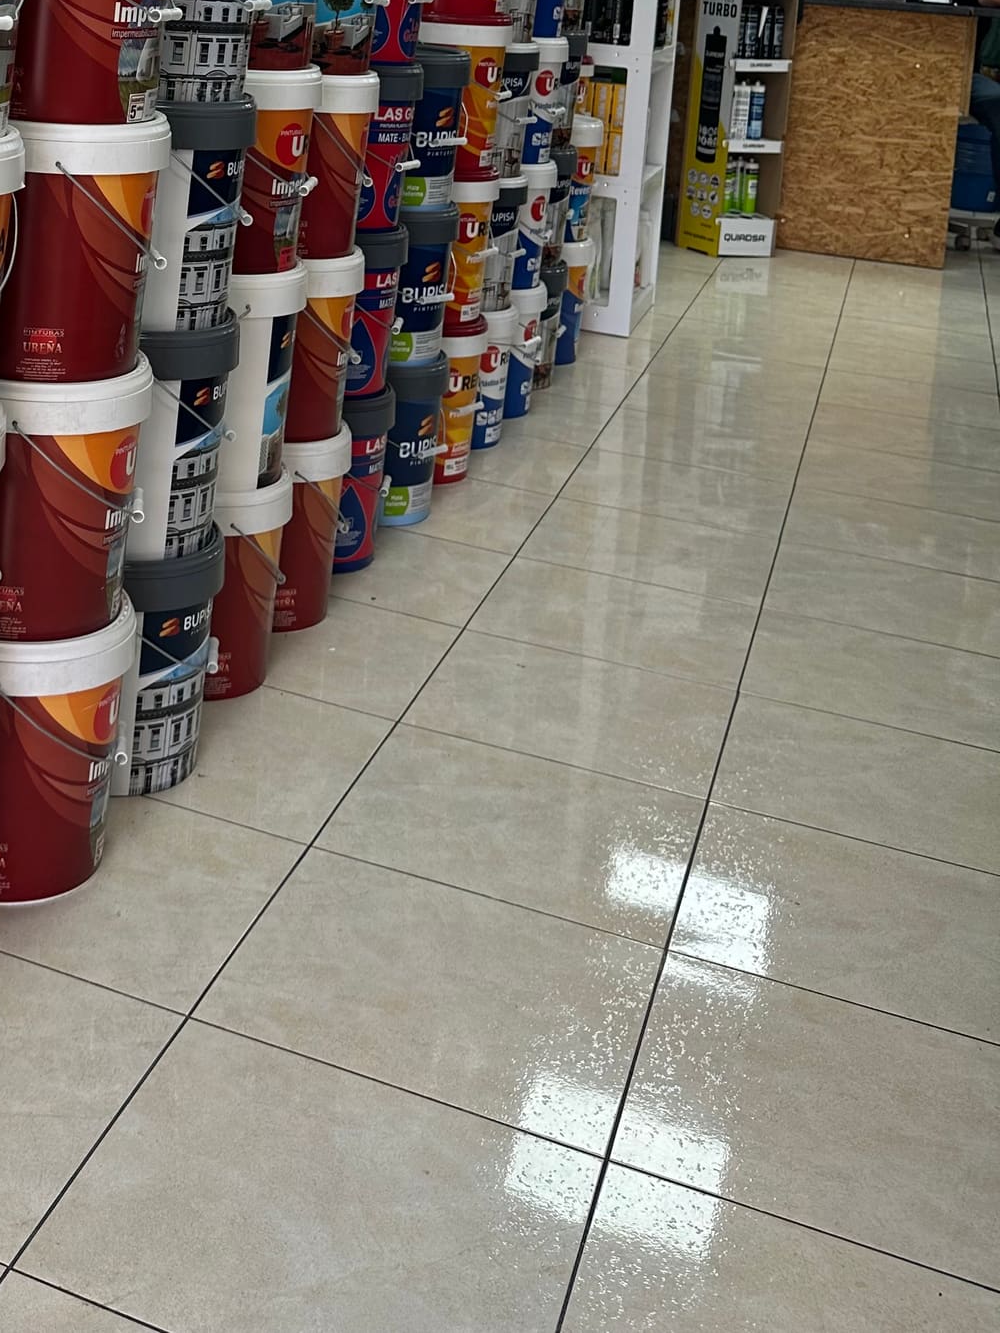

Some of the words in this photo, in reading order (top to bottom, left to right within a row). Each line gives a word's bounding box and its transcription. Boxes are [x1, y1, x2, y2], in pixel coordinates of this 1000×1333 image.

[702, 1, 738, 18] TURBO
[129, 102, 137, 119] 5
[374, 107, 403, 121] LAS
[378, 132, 399, 143] MATE
[724, 233, 766, 243] QUIADSA
[376, 273, 397, 288] LAS
[23, 340, 62, 354] UREÑA
